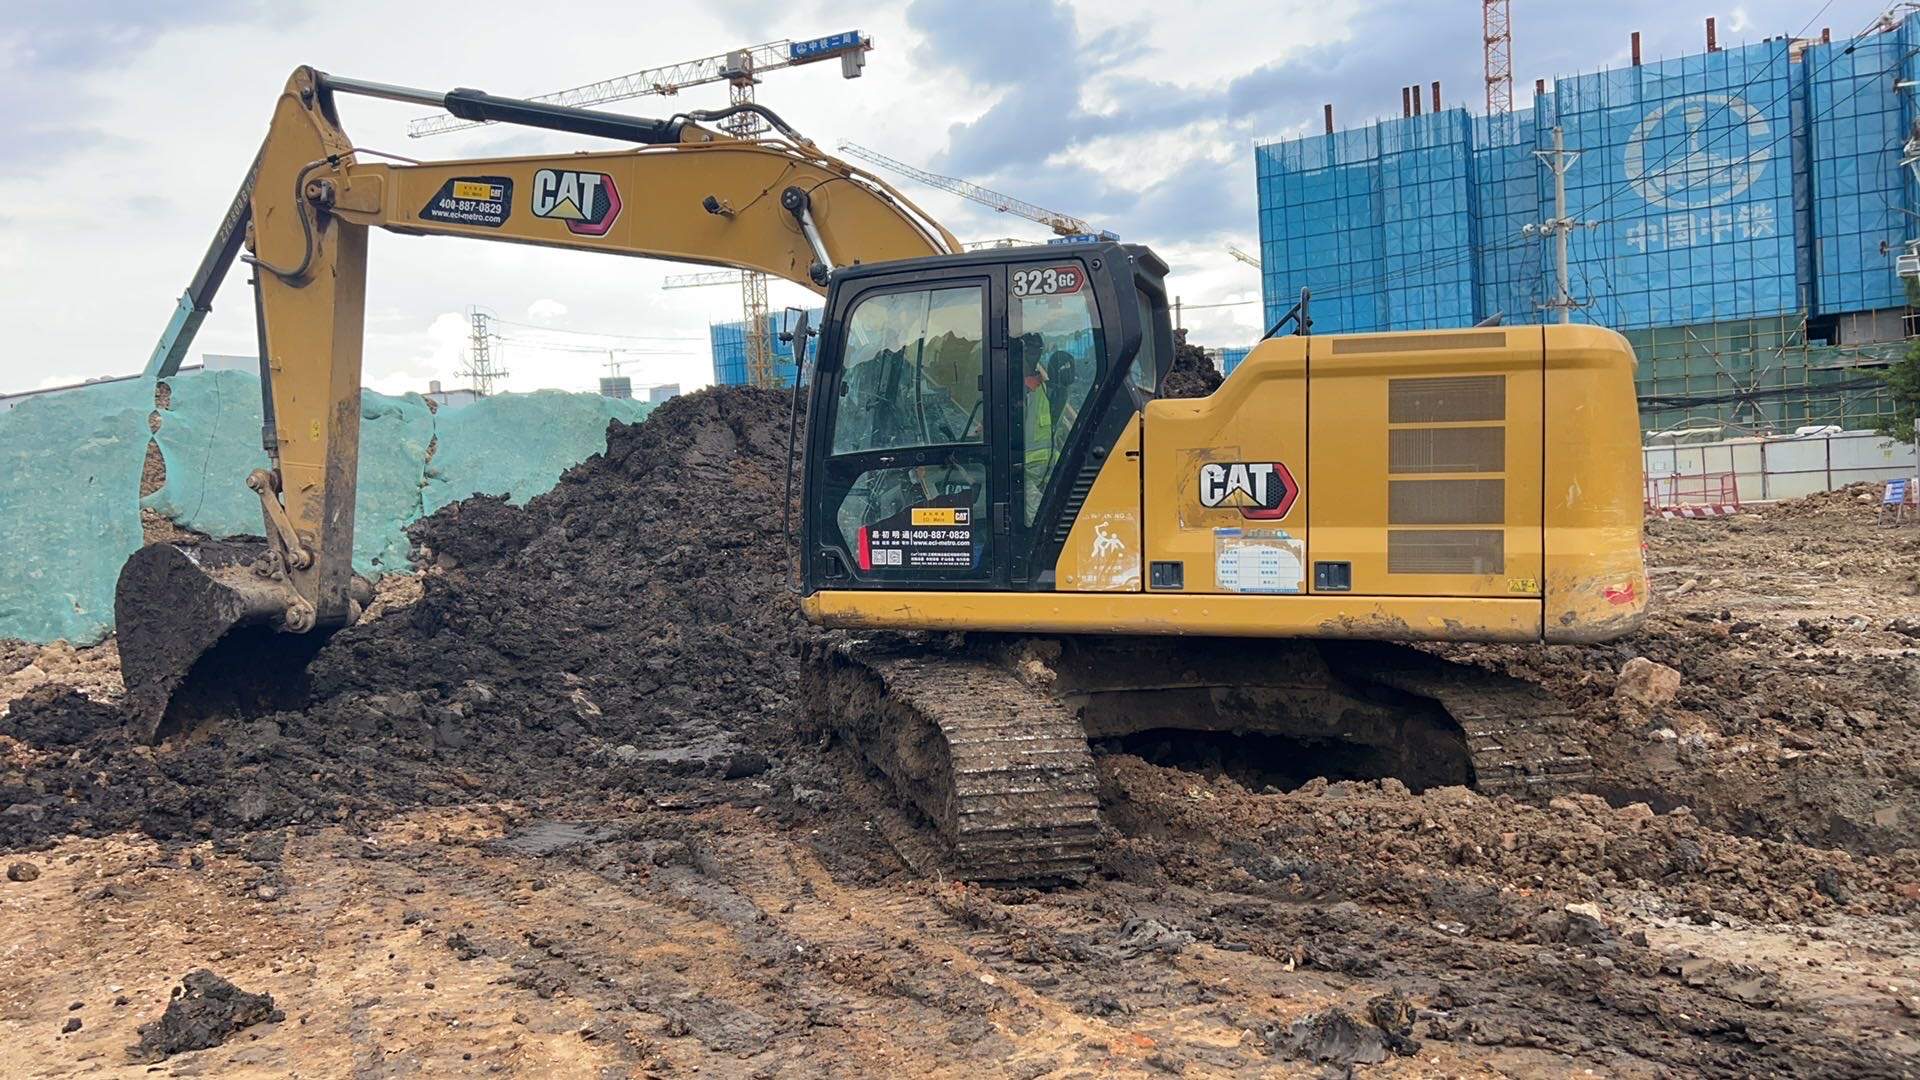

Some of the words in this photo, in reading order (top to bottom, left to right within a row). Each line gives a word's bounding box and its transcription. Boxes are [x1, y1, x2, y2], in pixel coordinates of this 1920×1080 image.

[809, 33, 852, 51] 中铁二局
[490, 189, 501, 197] CAT
[533, 169, 600, 220] CAT
[439, 198, 502, 214] 400-887-0829
[431, 209, 502, 223] www.eci-metro.com
[1626, 203, 1776, 254] 中国中铁
[1013, 269, 1058, 296] 323
[1058, 273, 1075, 287] GC
[1200, 463, 1273, 506] CAT
[955, 512, 968, 521] CAT
[913, 531, 970, 539] 400-887-0829
